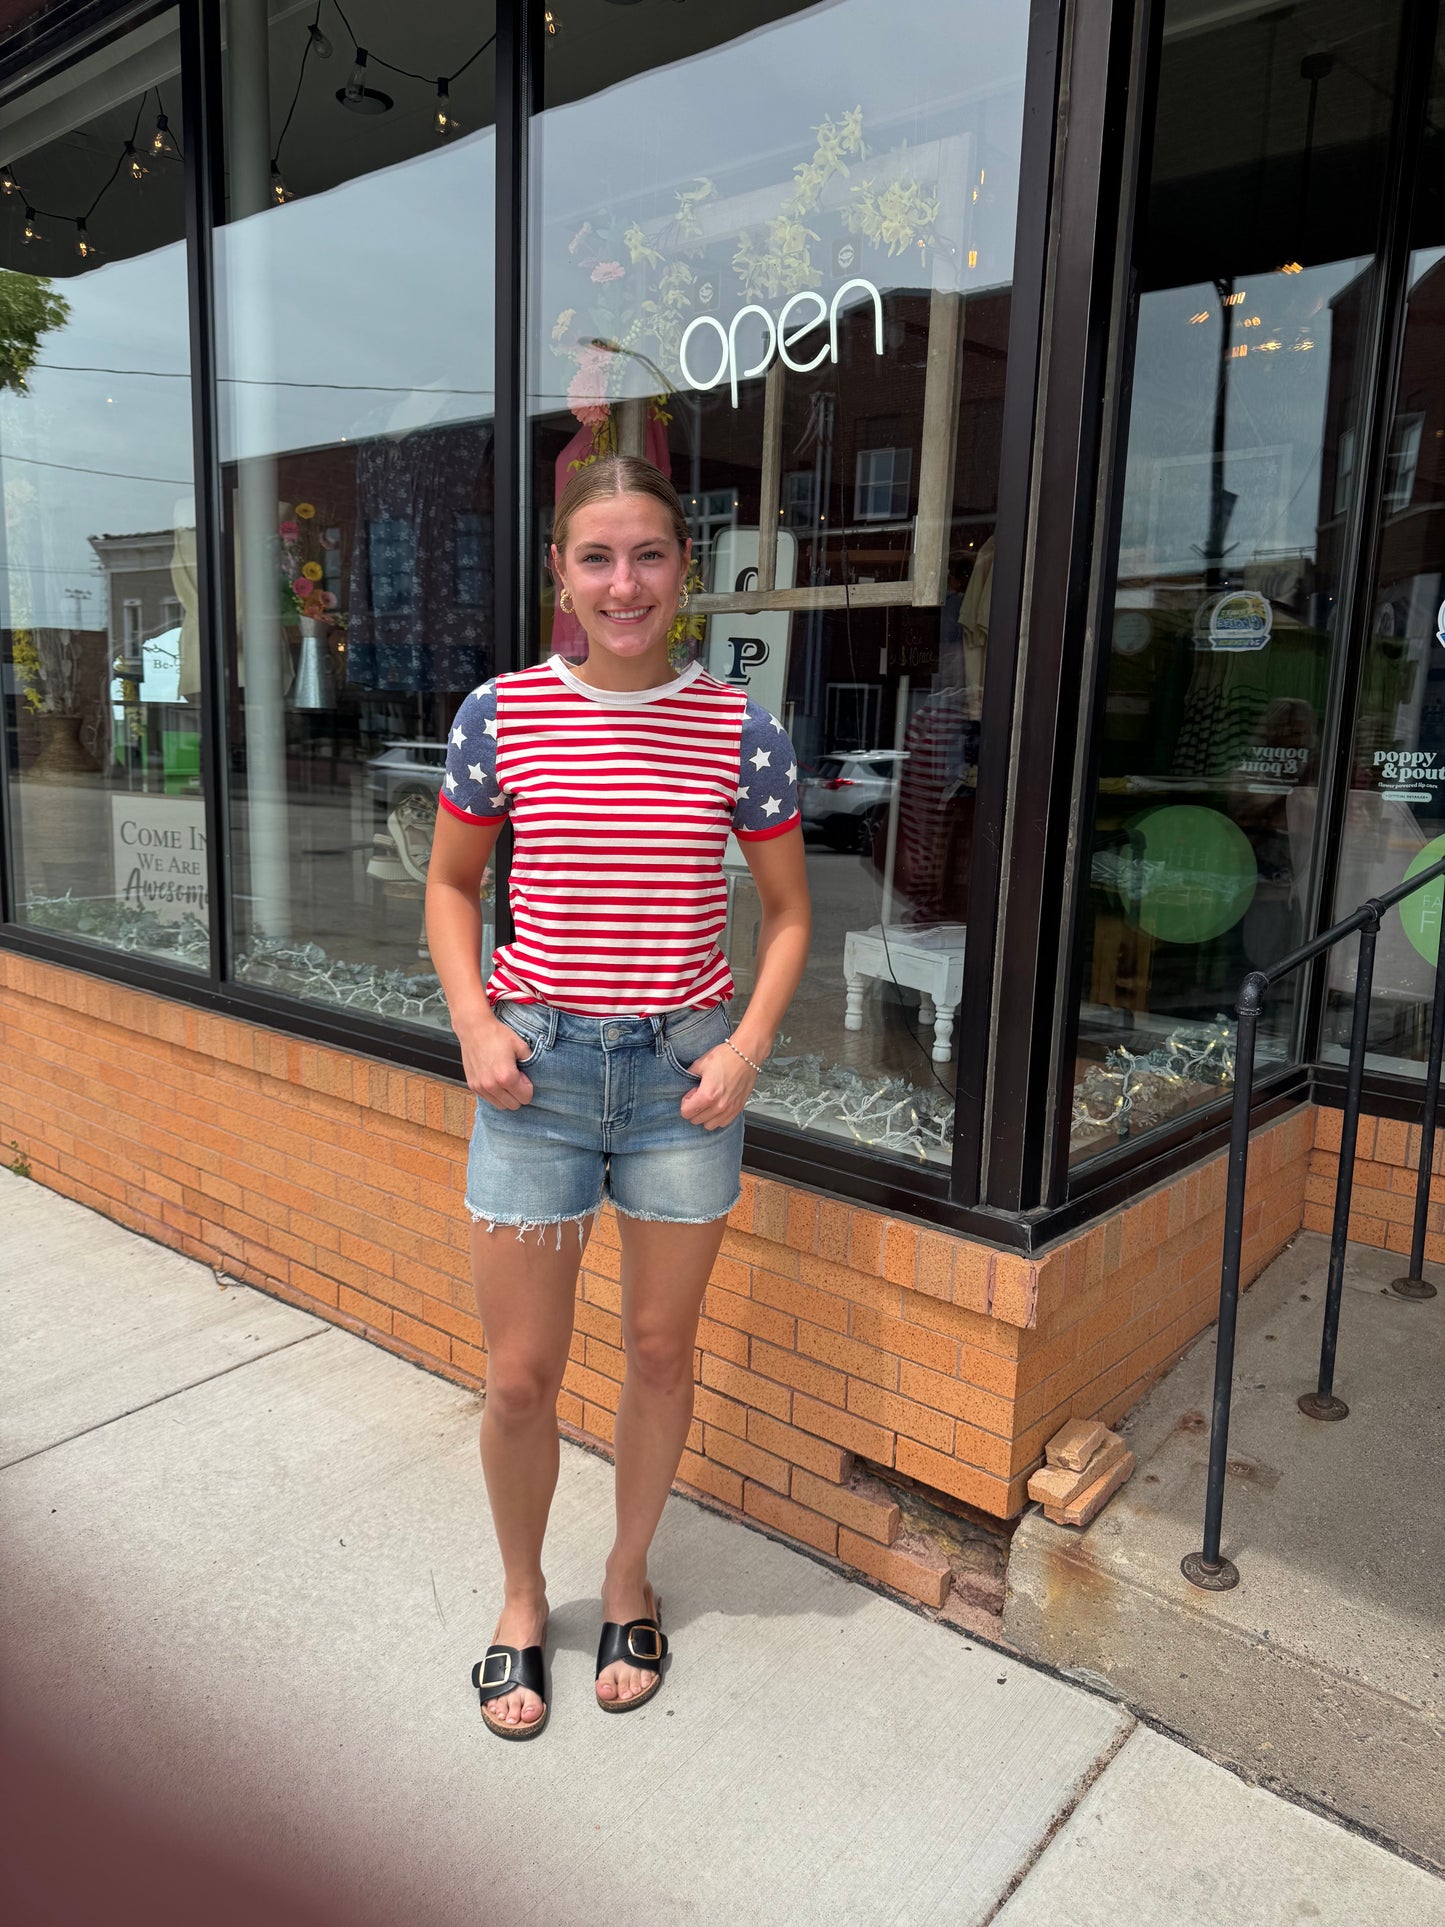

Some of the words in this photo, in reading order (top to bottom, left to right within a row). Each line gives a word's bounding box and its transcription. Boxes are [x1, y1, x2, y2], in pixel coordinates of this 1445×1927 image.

[681, 278, 884, 409] open
[1373, 750, 1437, 768] poppy
[120, 820, 182, 849] COME
[137, 852, 163, 872] WE
[168, 855, 201, 876] ARE
